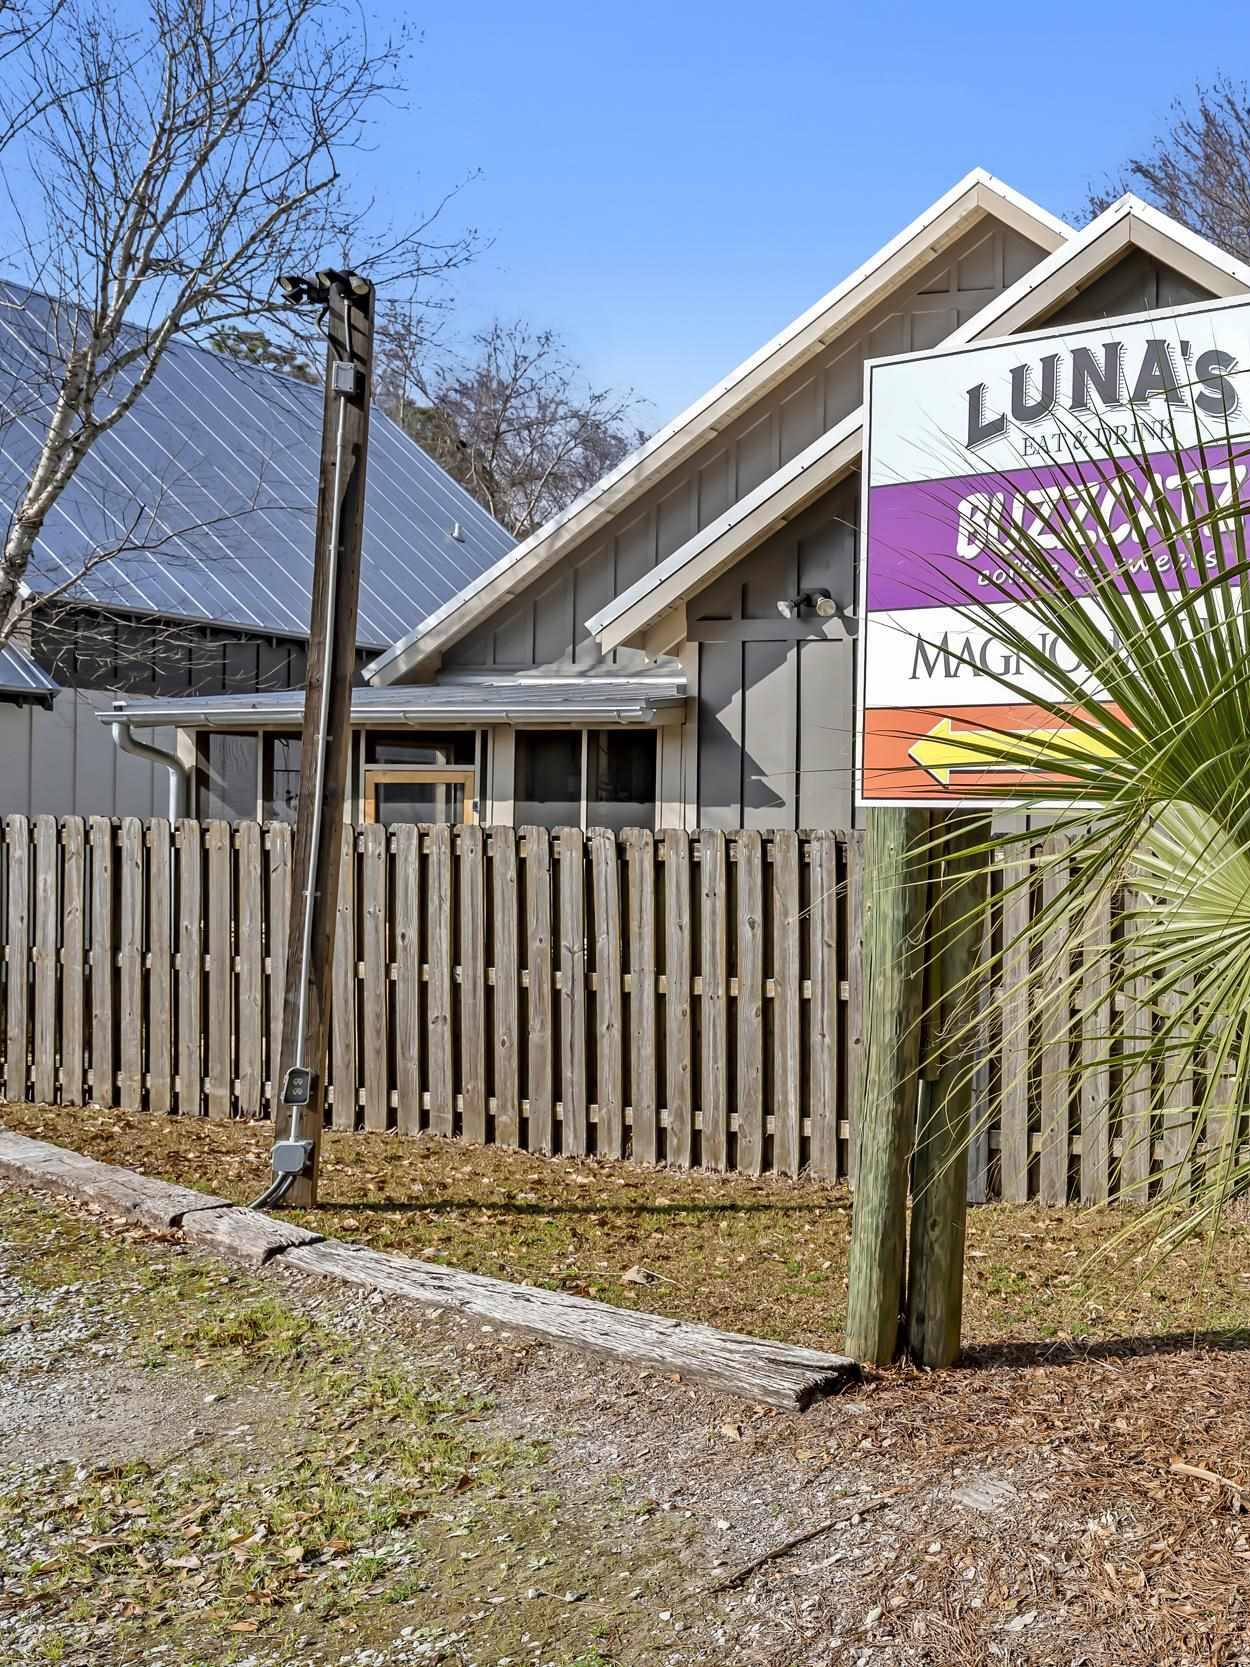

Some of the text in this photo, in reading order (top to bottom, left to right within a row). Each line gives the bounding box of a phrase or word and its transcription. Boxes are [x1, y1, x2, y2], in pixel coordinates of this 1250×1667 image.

[1022, 418, 1174, 457] EAT & DRINK
[908, 626, 1152, 680] MAGNO
